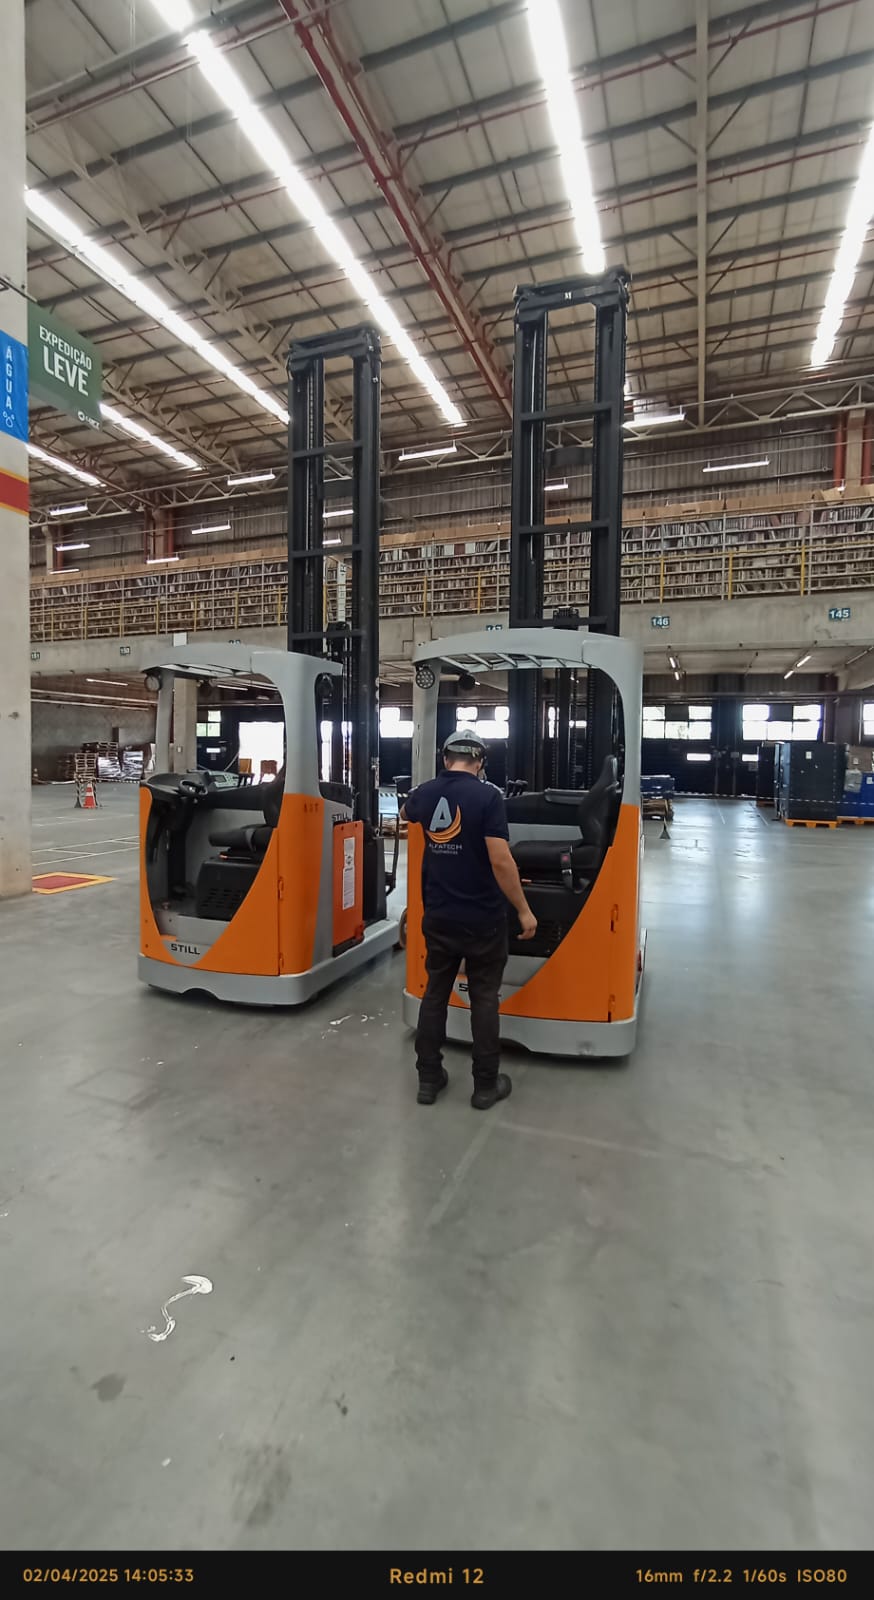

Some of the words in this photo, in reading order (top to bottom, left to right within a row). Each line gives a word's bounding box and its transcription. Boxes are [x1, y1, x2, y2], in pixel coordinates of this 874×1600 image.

[40, 325, 92, 370] EXPEDIÇÃO
[43, 345, 88, 396] LEVE
[829, 609, 849, 619] 145
[652, 617, 669, 626] 146
[170, 943, 200, 955] STILL
